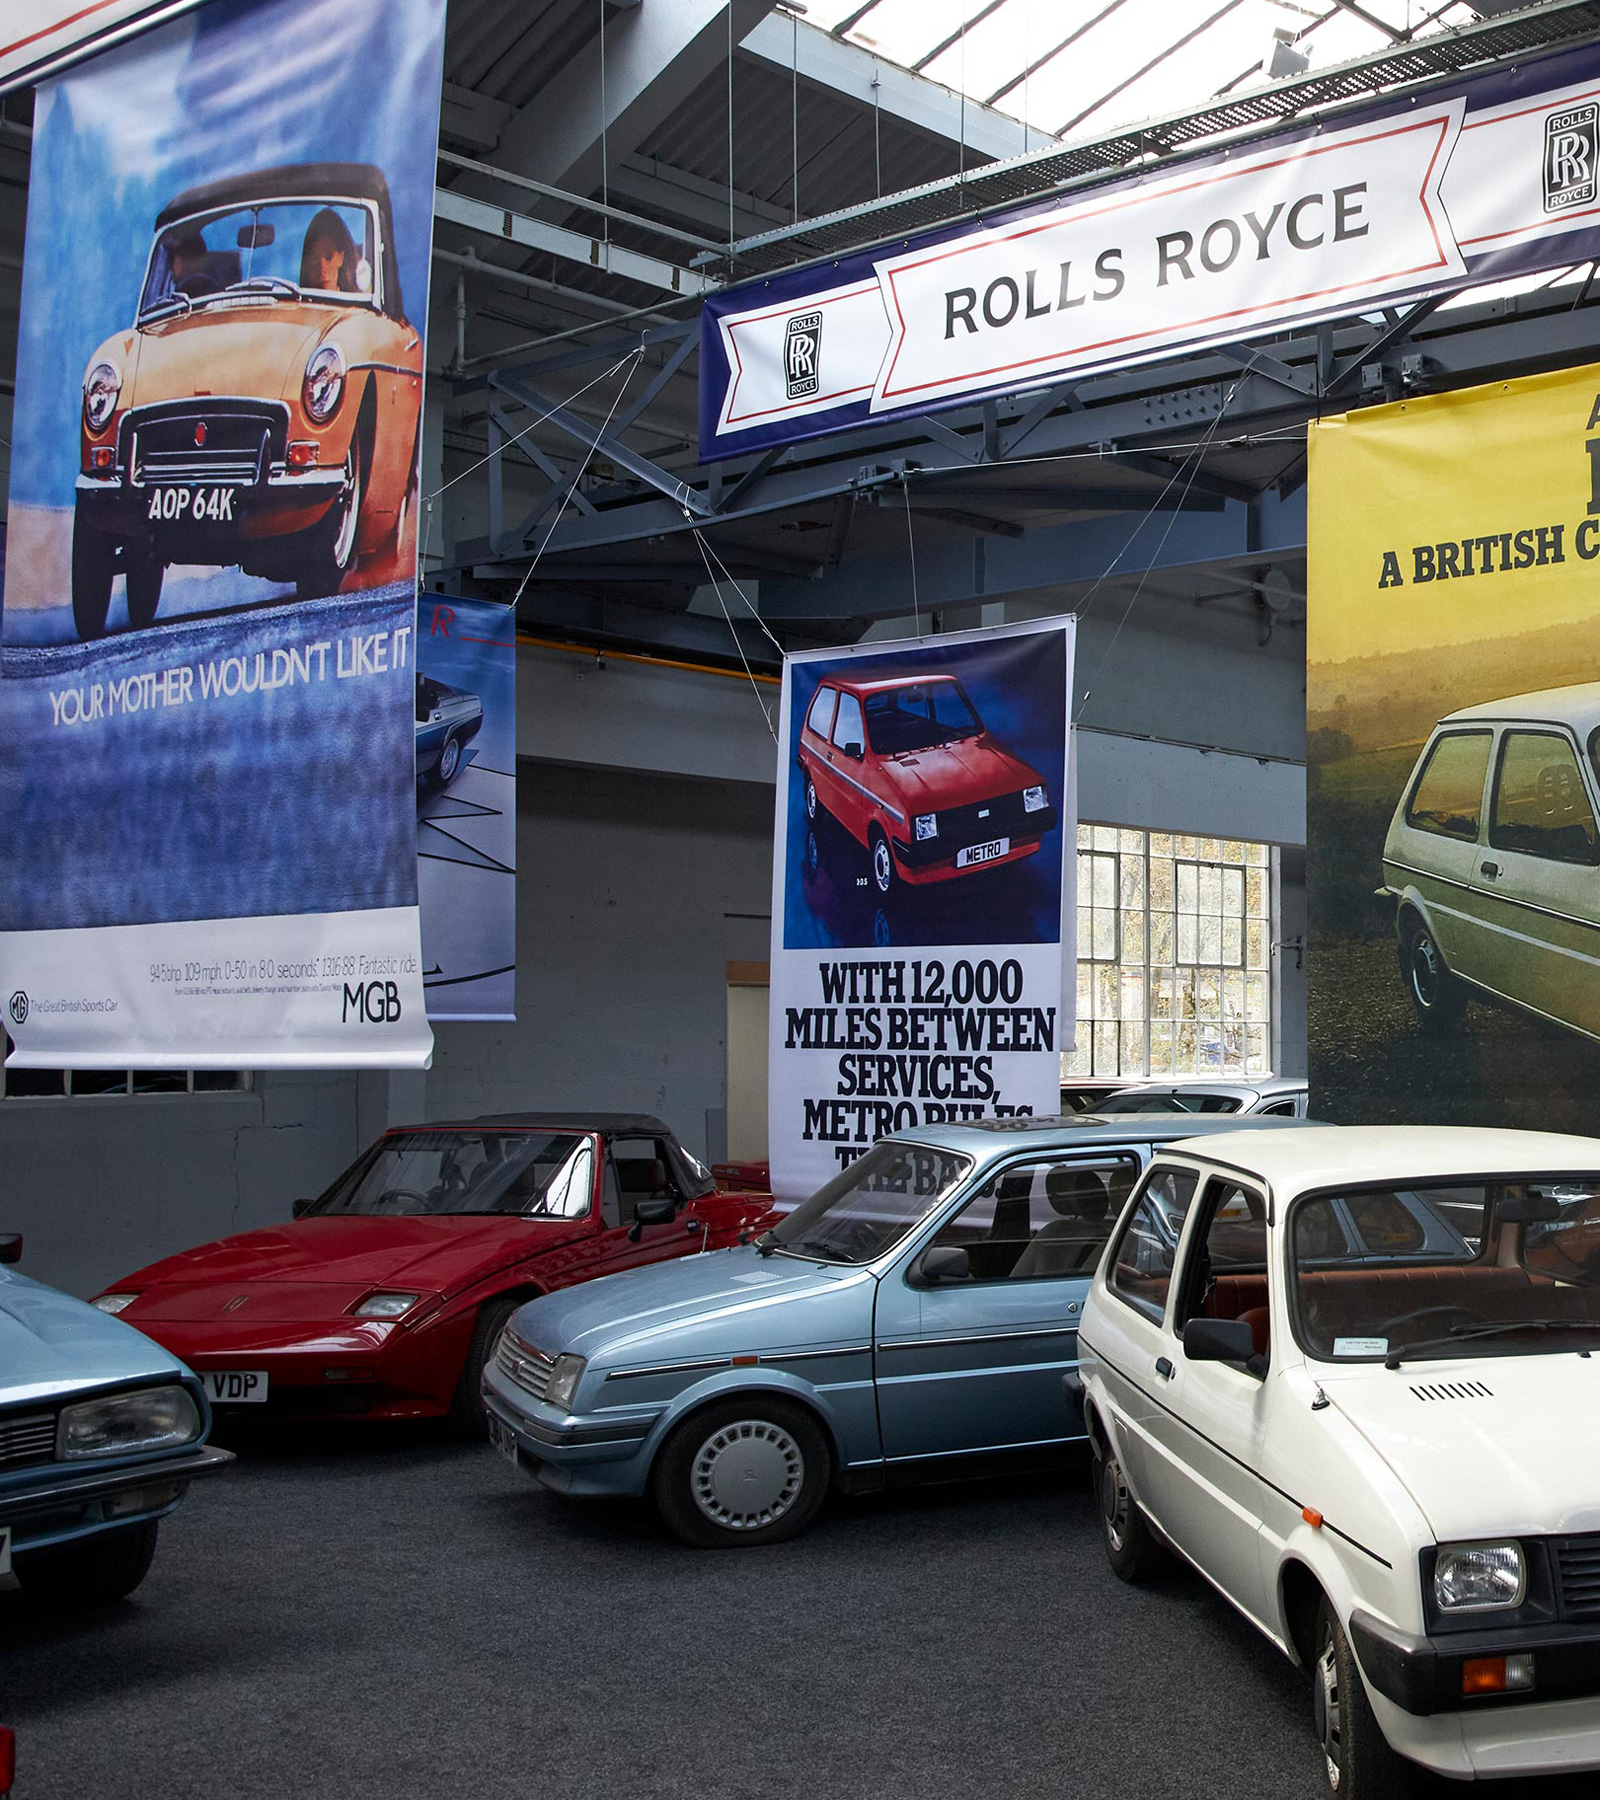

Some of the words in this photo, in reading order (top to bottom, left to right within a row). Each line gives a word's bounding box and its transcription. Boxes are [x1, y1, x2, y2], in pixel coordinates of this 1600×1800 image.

[1552, 109, 1593, 131] ROLLS
[1550, 186, 1590, 207] ROYCE
[943, 248, 1125, 340] ROLLS
[1156, 181, 1370, 287] ROYCE
[791, 316, 818, 332] ROLLS
[791, 380, 815, 394] ROYCE
[148, 488, 190, 519] AOP
[192, 488, 235, 520] 64K
[1378, 550, 1404, 588] A
[1412, 524, 1565, 584] BRITISH
[49, 685, 104, 726] YOUR
[108, 666, 194, 716] MOTHER
[199, 642, 331, 700] WOULDN'T
[337, 632, 388, 679] LIKE
[393, 626, 411, 670] IT
[966, 841, 1001, 863] METRO
[342, 980, 402, 1023] MGB
[818, 960, 906, 1004] WITH
[911, 958, 1023, 1008] 12,000
[82, 998, 104, 1014] Sports
[784, 1007, 882, 1050] MILES
[886, 1006, 1056, 1052] BETWEEN
[837, 1053, 1002, 1105] SERVICES,
[803, 1099, 918, 1143] METRO
[213, 1374, 258, 1397] VDP
